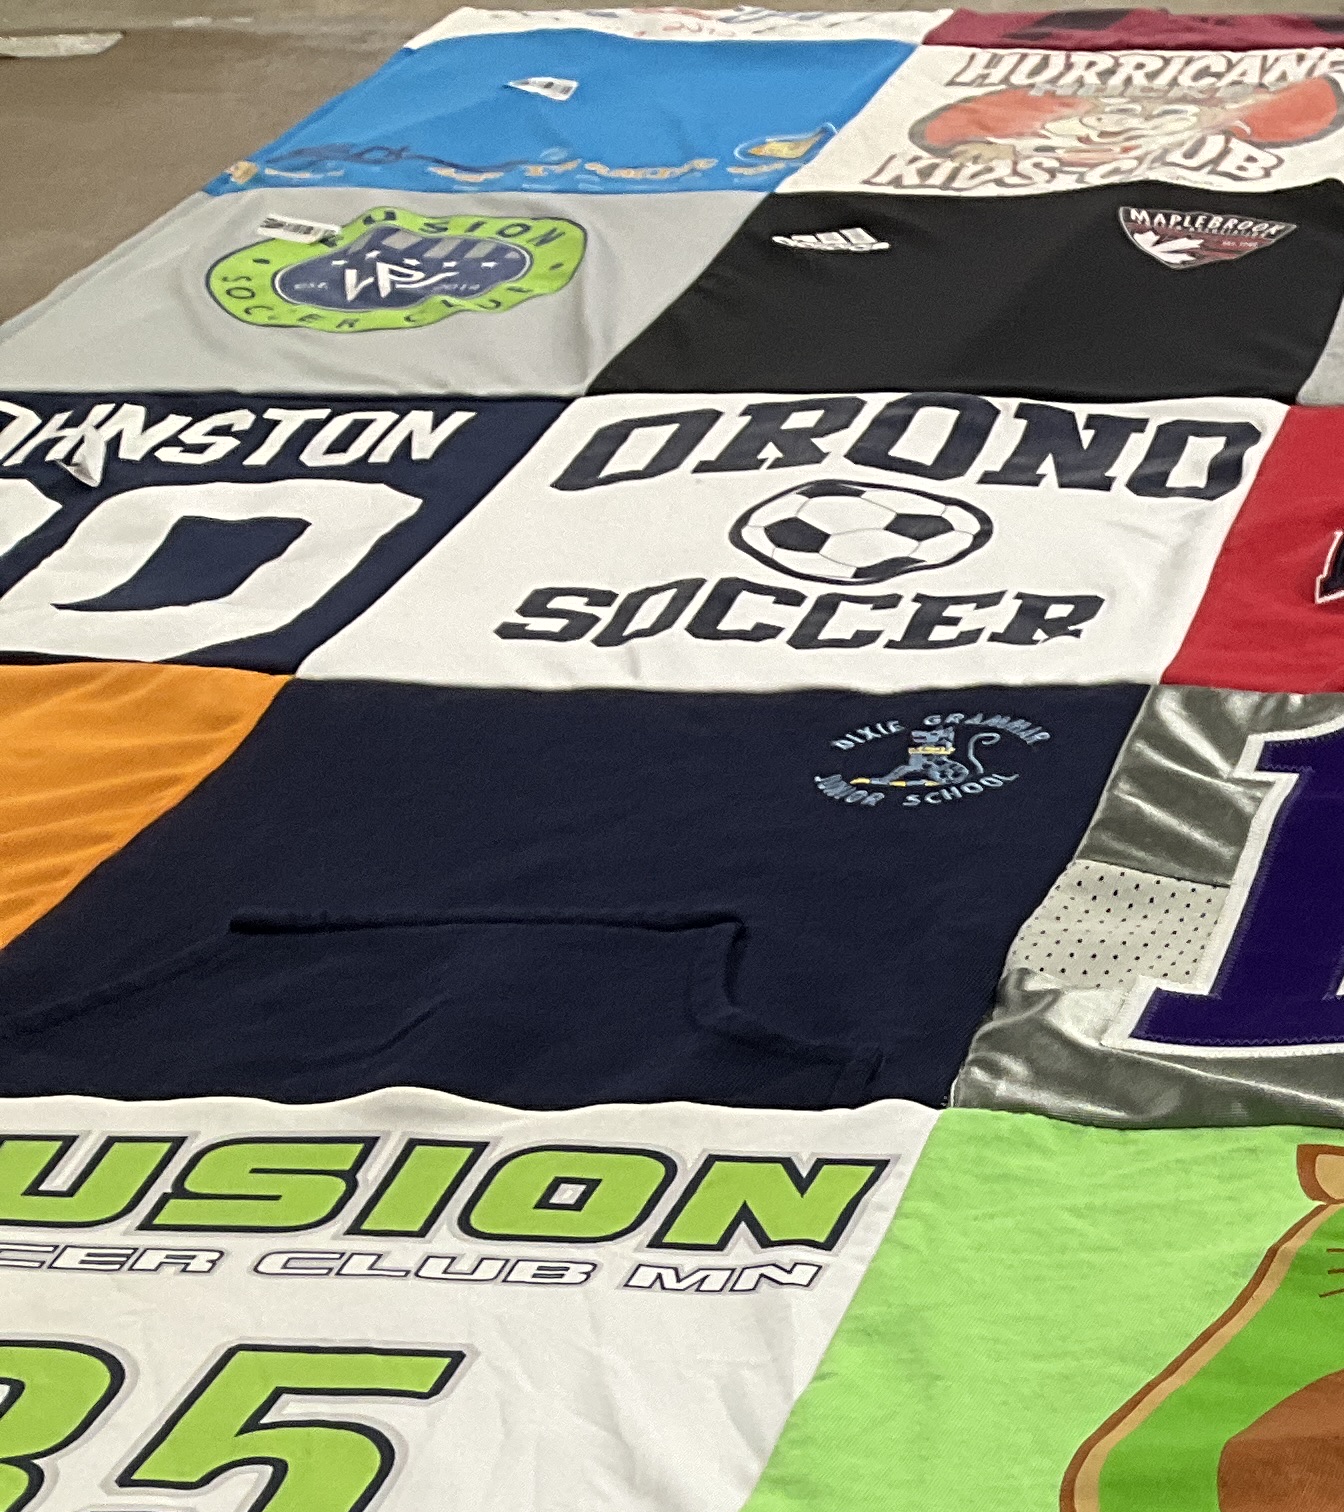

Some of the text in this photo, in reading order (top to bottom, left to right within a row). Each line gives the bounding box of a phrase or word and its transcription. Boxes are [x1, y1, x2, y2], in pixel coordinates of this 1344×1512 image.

[318, 208, 568, 248] USION
[1130, 207, 1287, 238] MAPLEBROOK
[551, 392, 1262, 500] ORONO
[0, 478, 424, 662] 0
[494, 577, 1113, 649] SOCCER
[830, 719, 906, 751] DIXIE
[902, 773, 1021, 807] SCHOOL
[0, 1134, 893, 1254] USION
[0, 1241, 823, 1294] CER CLUB MN
